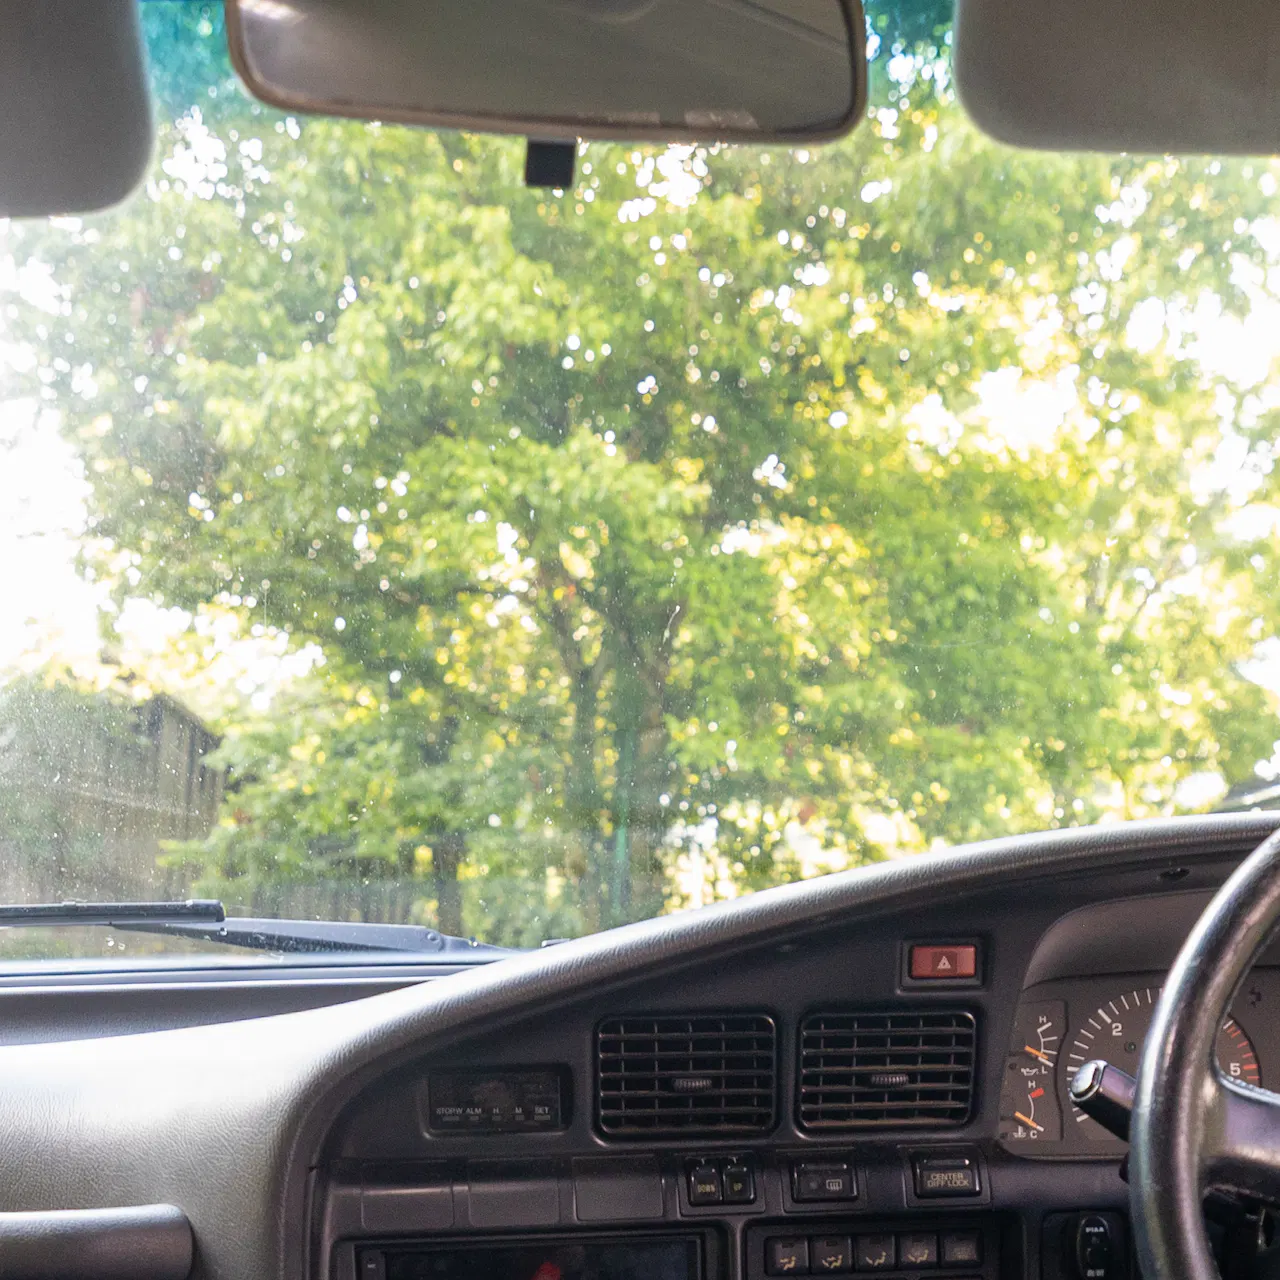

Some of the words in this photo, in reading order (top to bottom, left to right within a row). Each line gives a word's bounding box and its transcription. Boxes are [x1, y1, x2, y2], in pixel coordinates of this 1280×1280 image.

[1112, 1023, 1122, 1036] 2
[1230, 1063, 1241, 1076] 5
[930, 1172, 964, 1181] CENTER
[927, 1180, 946, 1188] DIFF
[947, 1179, 970, 1188] LOCK
